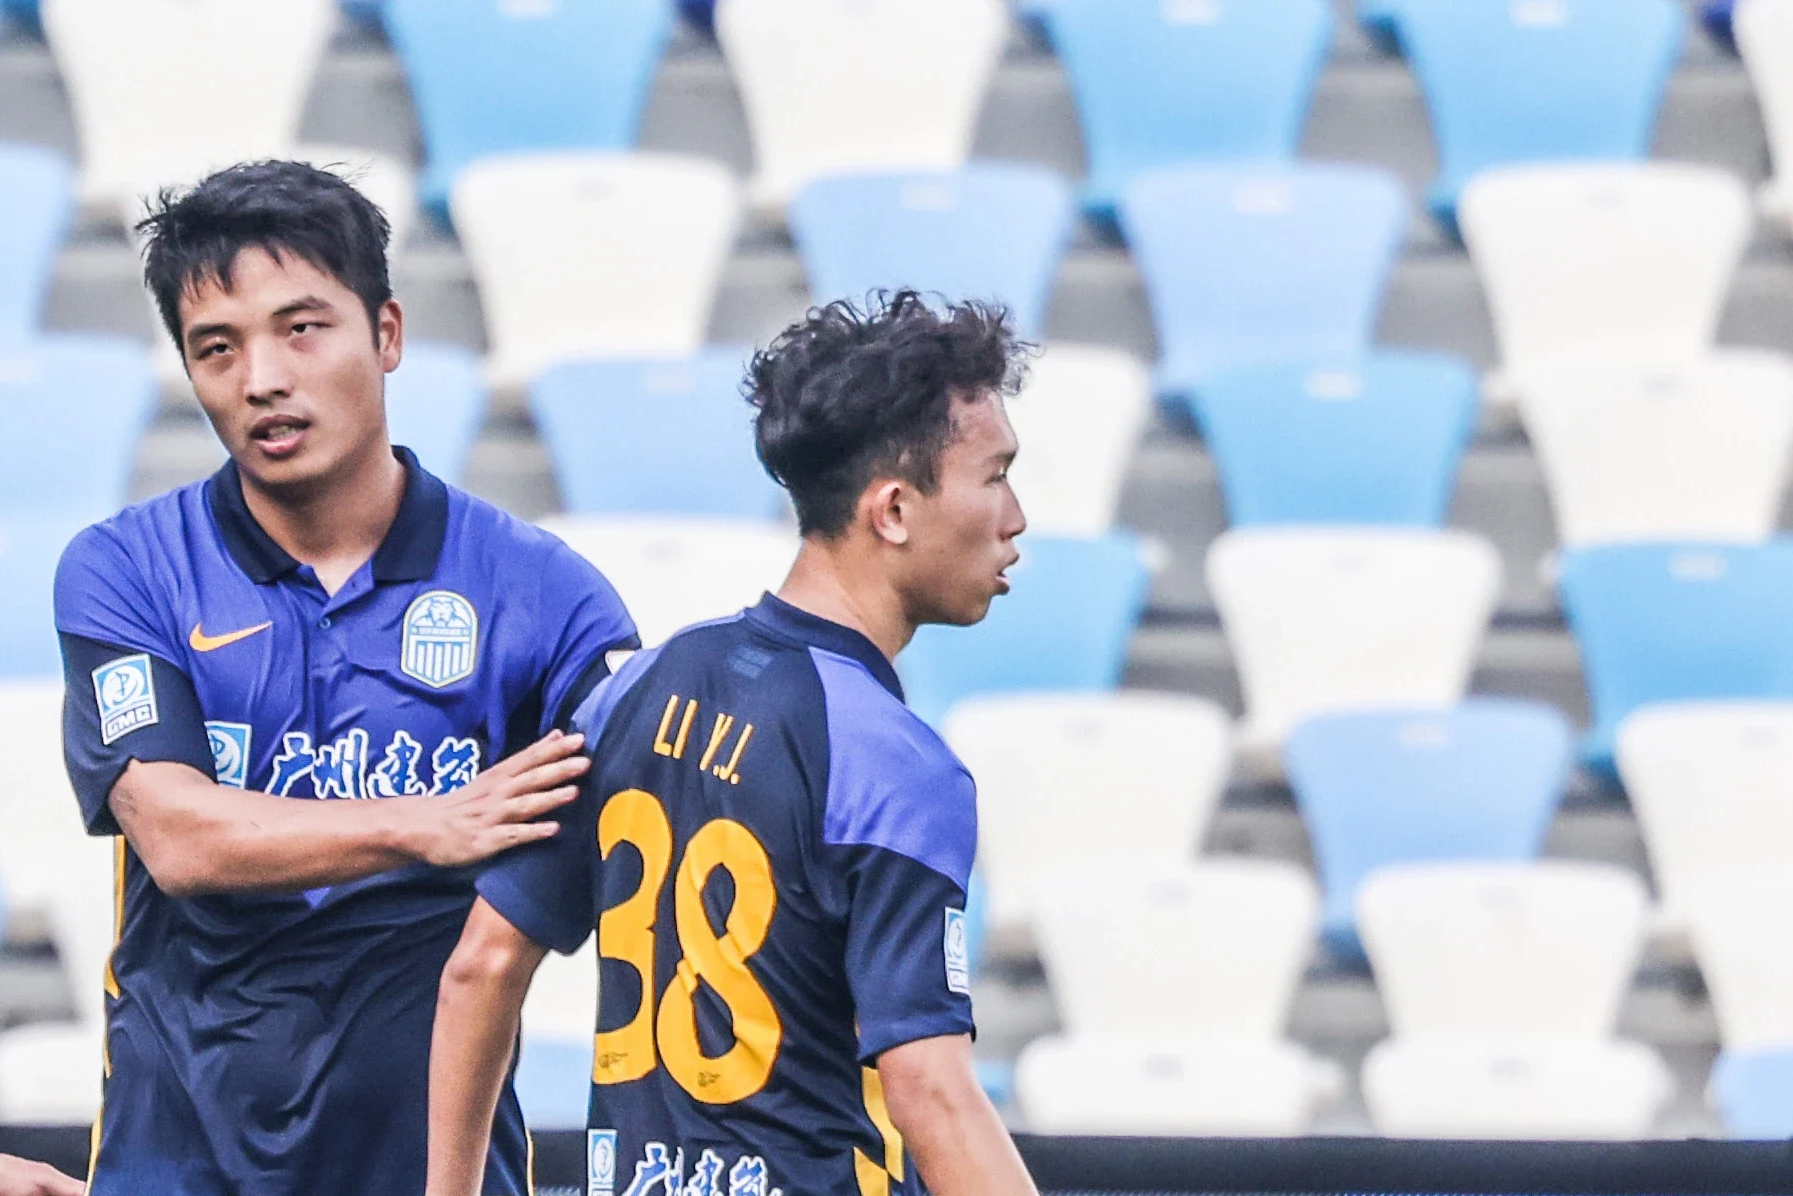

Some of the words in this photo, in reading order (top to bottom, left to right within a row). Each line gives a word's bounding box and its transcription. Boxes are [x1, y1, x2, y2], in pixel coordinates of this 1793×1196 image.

[105, 704, 152, 738] GMC
[653, 694, 700, 760] LI
[592, 788, 783, 1106] 38
